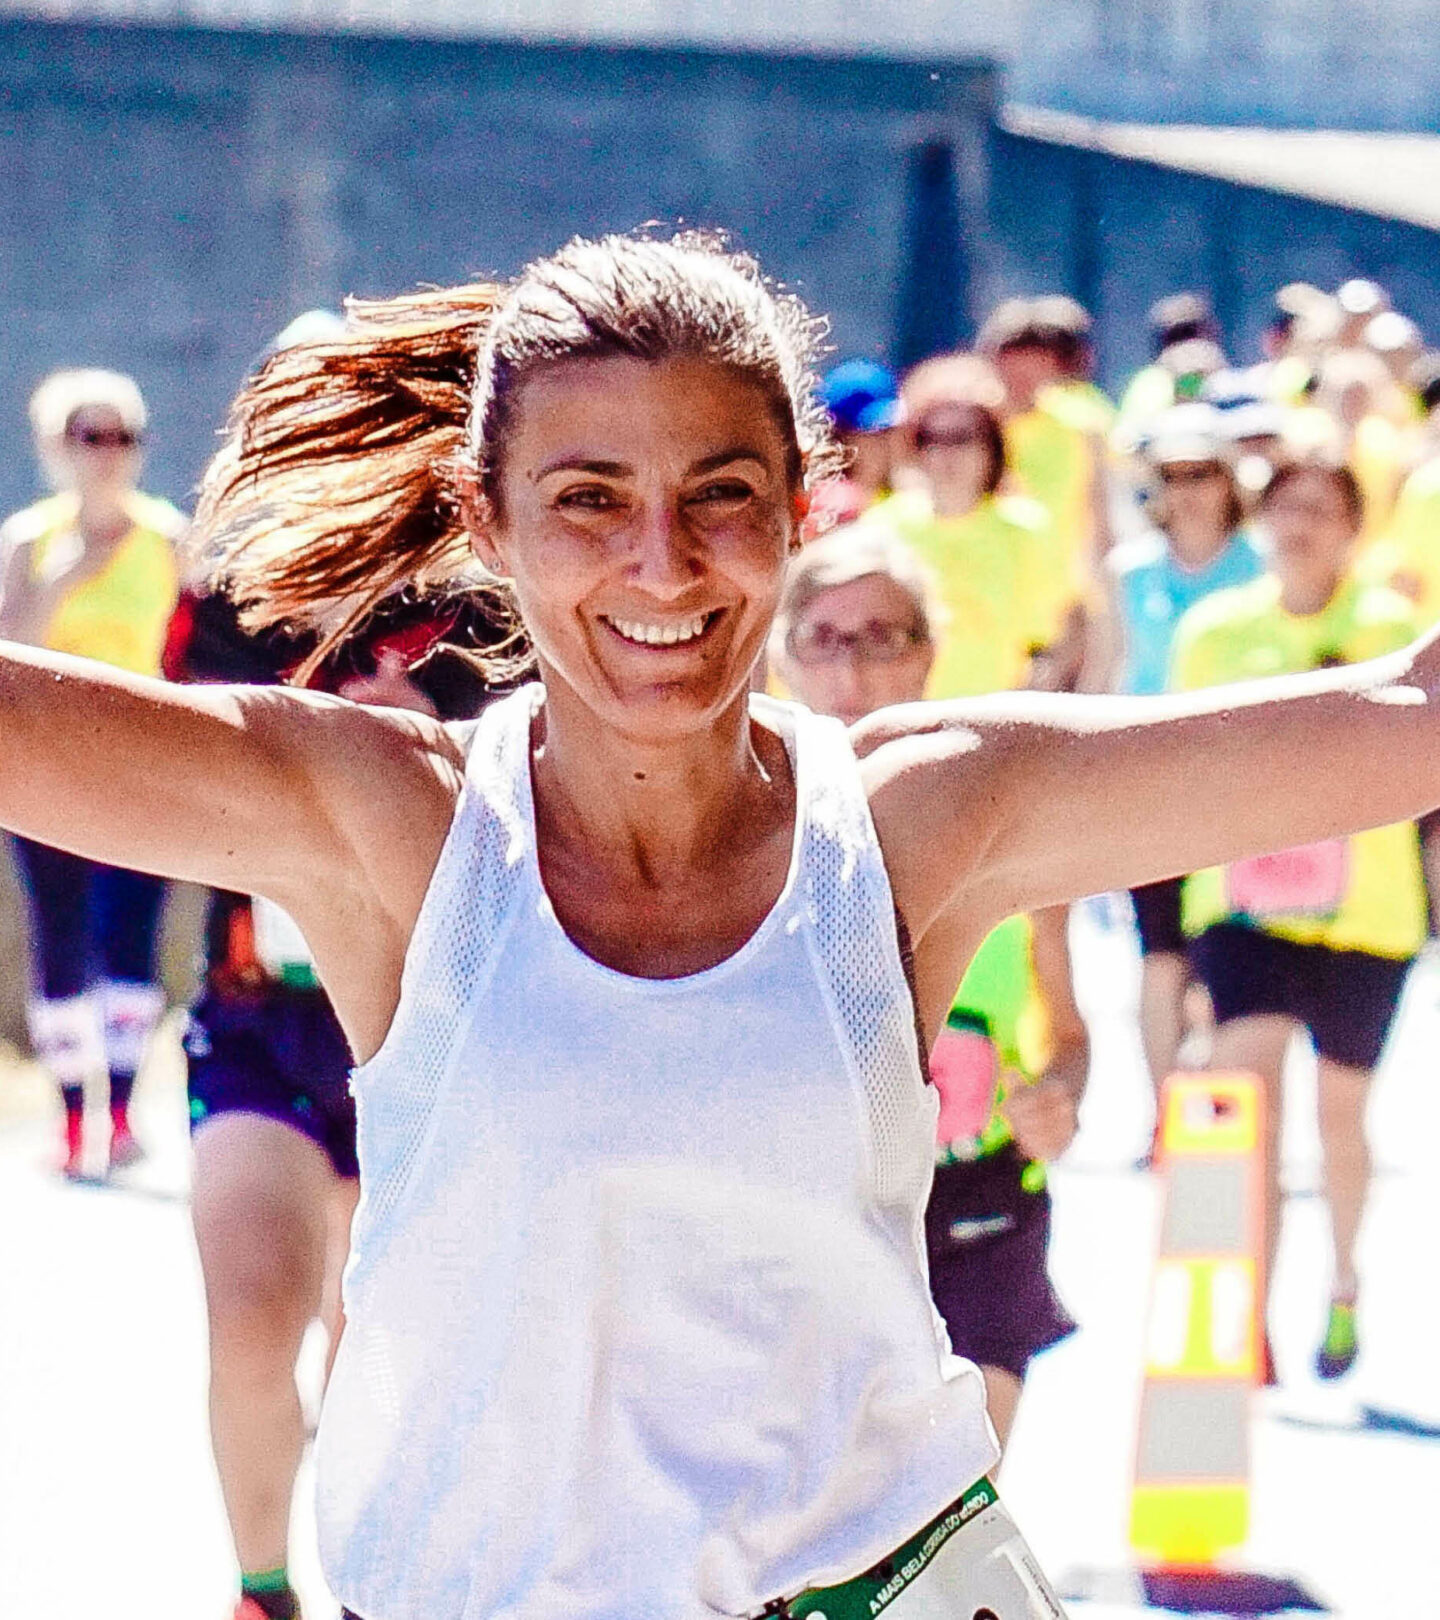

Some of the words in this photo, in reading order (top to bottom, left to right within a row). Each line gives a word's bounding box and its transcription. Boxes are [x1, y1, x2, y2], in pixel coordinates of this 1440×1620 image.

[869, 1599, 881, 1615] A
[877, 1573, 905, 1605] MAIS
[901, 1551, 927, 1580] BELA
